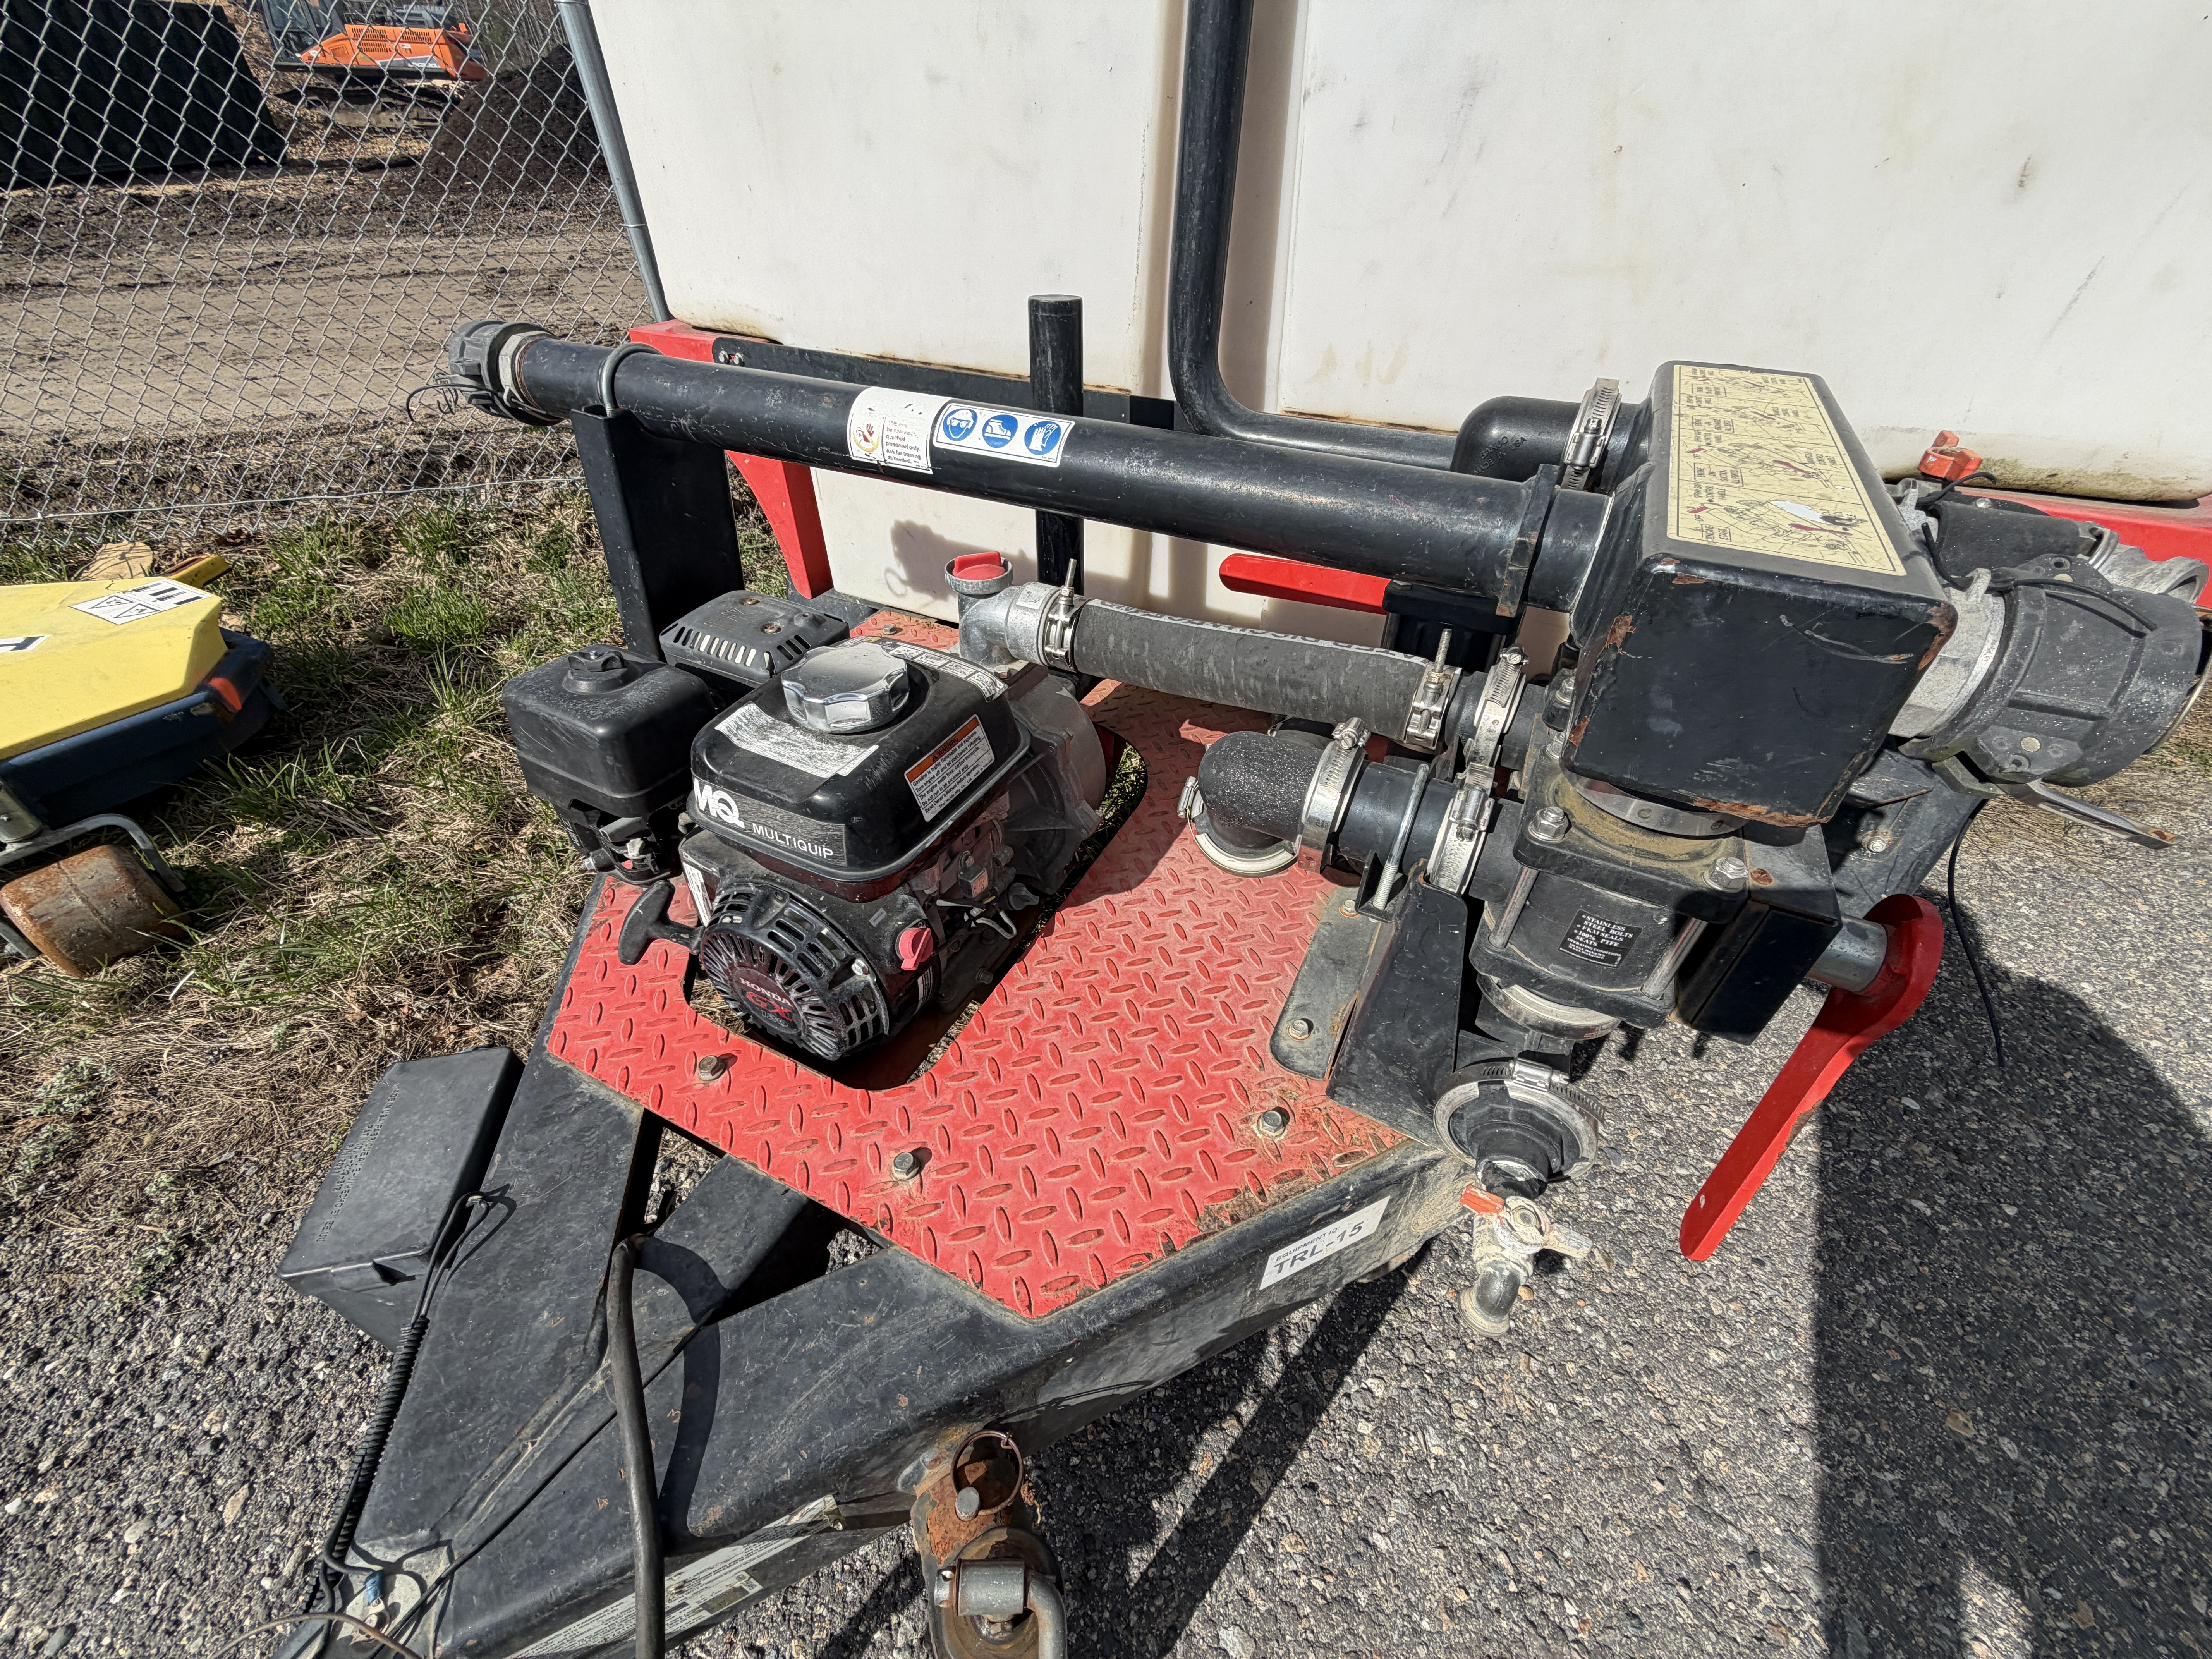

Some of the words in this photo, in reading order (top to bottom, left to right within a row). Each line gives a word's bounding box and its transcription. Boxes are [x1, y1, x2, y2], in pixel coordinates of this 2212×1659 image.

[1480, 436, 1508, 459] BANJO
[938, 736, 958, 756] WARNING
[913, 772, 927, 787] Gasoline
[931, 761, 941, 772] highly
[941, 747, 957, 763] flammable
[915, 784, 924, 793] Turn
[924, 775, 935, 787] engine
[950, 753, 958, 763] cool
[958, 746, 967, 757] before
[926, 783, 937, 795] engine
[938, 775, 946, 784] emits
[946, 768, 955, 776] toxic
[955, 758, 965, 769] carbon
[947, 770, 960, 784] enclosed
[694, 778, 745, 828] MQ
[924, 804, 934, 813] Read
[933, 793, 945, 805] Owner's
[946, 783, 957, 795] Manual
[957, 774, 966, 785] before
[752, 822, 833, 859] MULTIQUIP
[1582, 926, 1599, 935] FKM
[1600, 933, 1624, 941] SEALS
[1583, 921, 1606, 932] STEEL
[1609, 929, 1633, 938] BOLTS
[1586, 916, 1626, 931] STAINLESS
[1567, 938, 1594, 950] OPERATING
[1576, 936, 1598, 946] SEATS
[1578, 931, 1596, 941] 100%
[1600, 939, 1620, 947] PTFE
[739, 977, 793, 1007] HONDA
[746, 991, 793, 1022] GX
[1274, 1221, 1364, 1274] TRL-15
[1276, 1233, 1327, 1261] EQUIPMENT
